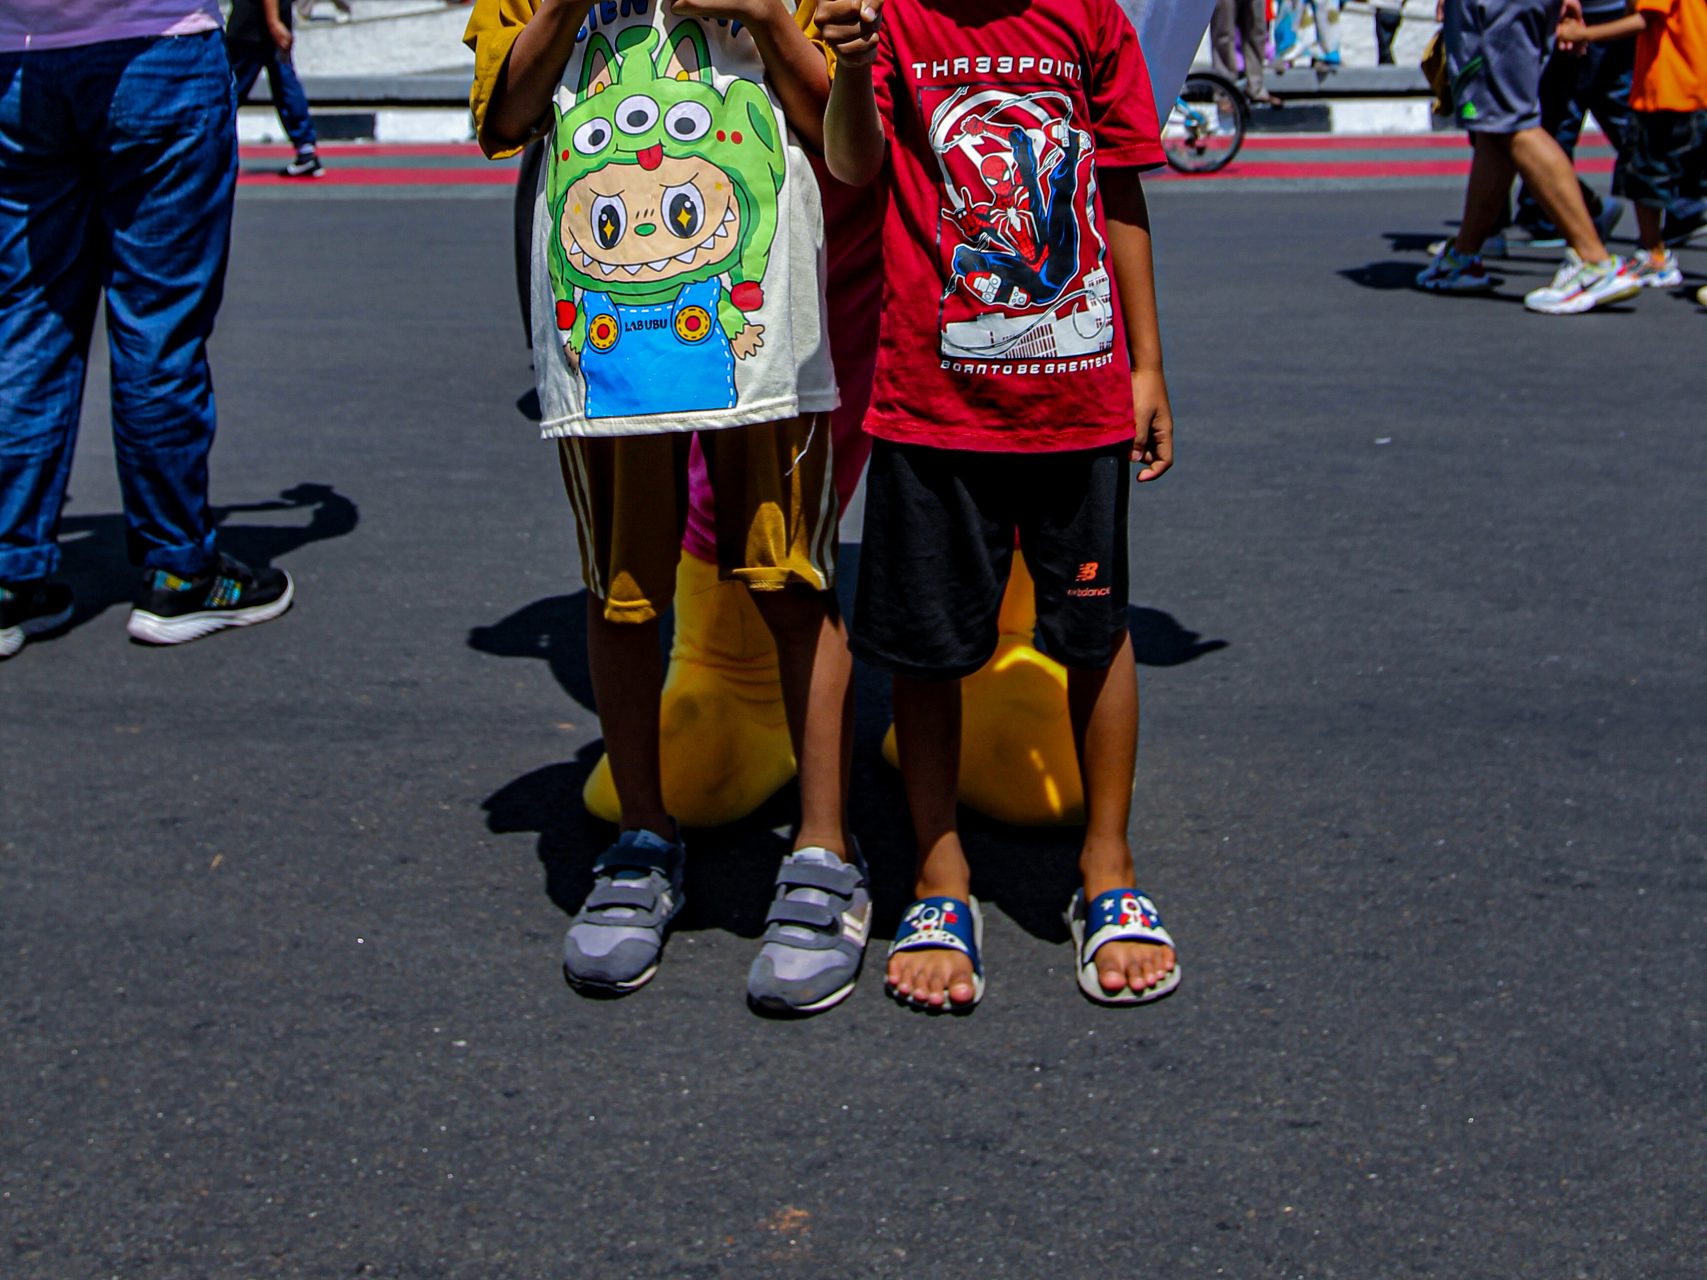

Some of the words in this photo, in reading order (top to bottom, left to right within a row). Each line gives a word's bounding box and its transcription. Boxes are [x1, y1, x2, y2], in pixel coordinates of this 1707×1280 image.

[624, 319, 668, 332] LABUBU
[940, 360, 986, 375] BORN
[991, 364, 1012, 375] TO
[1016, 364, 1040, 374] BE
[1044, 353, 1113, 374] GREATEST
